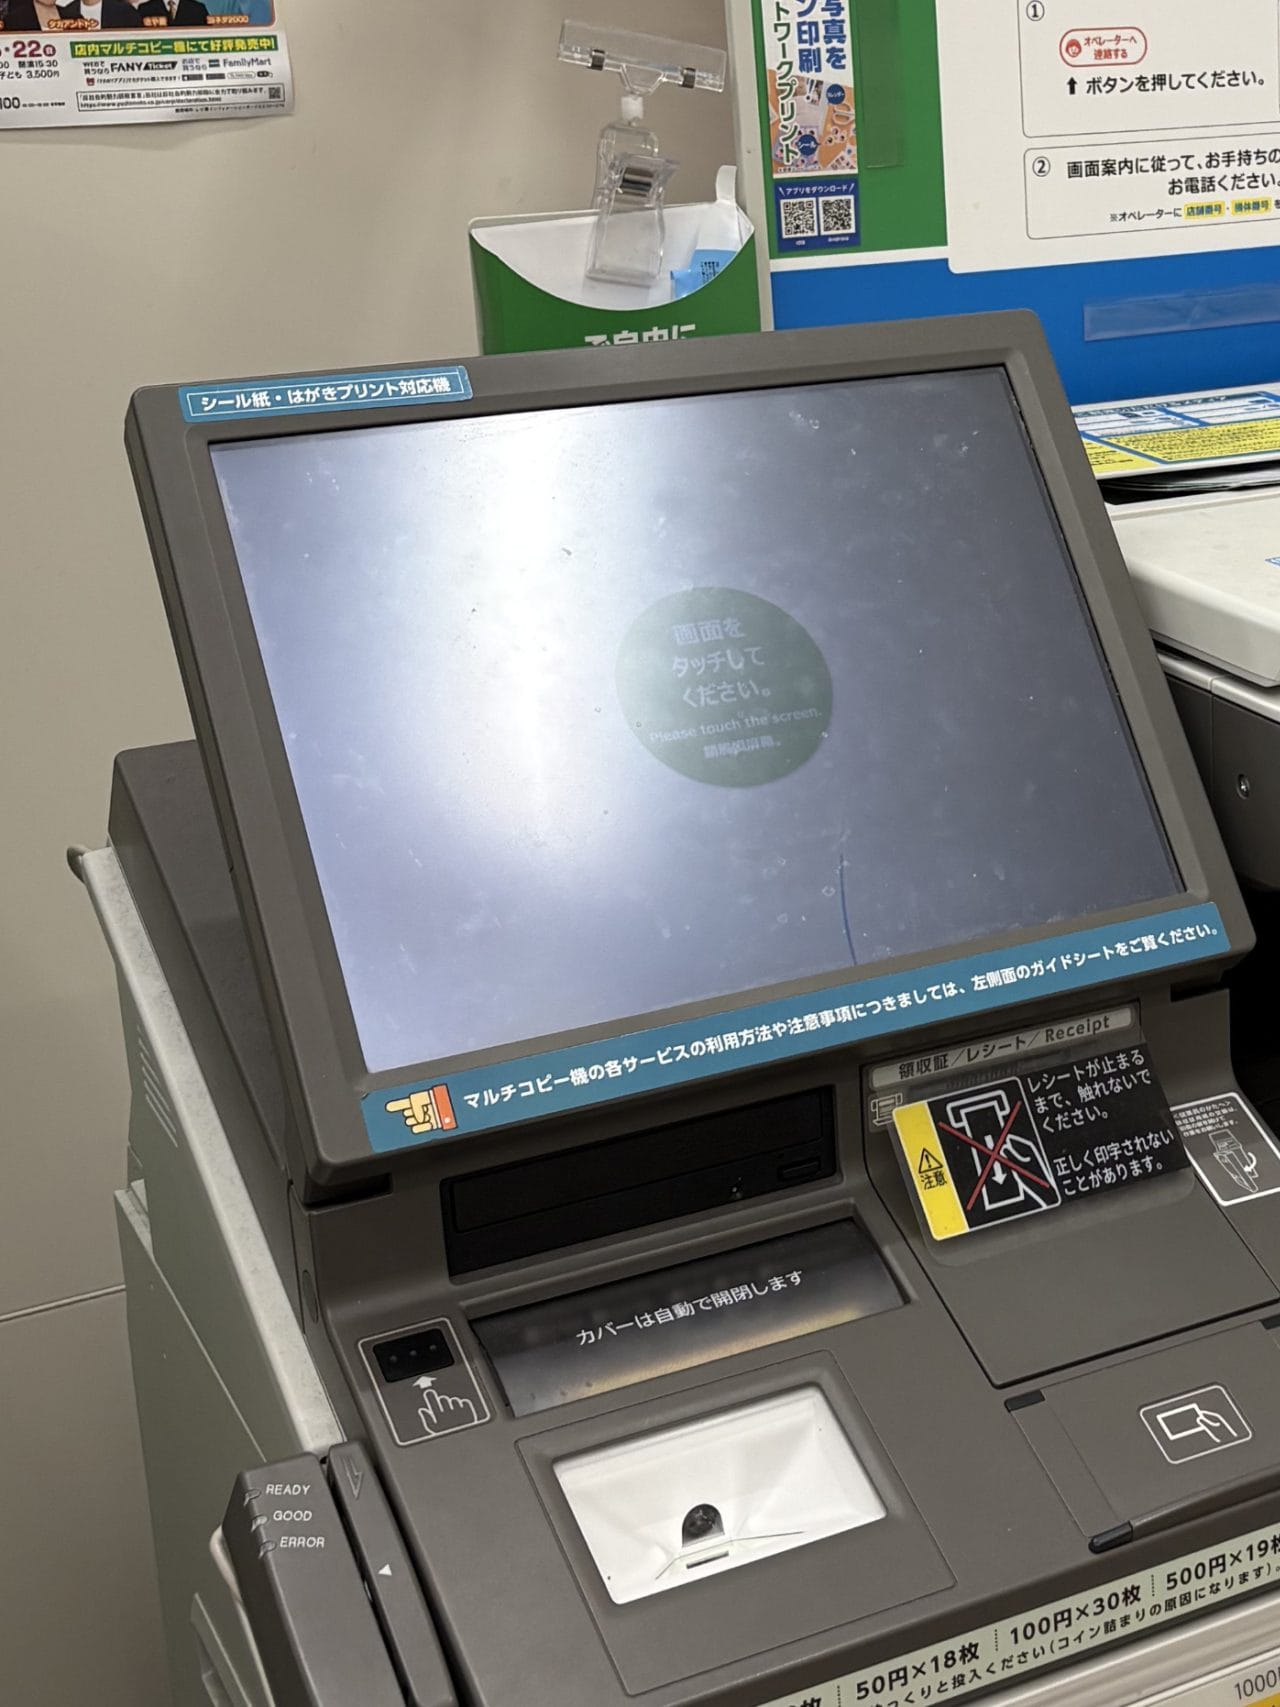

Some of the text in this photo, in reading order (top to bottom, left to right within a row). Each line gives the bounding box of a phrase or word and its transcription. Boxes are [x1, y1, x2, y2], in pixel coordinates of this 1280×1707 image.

[1083, 34, 1138, 48] オペレーターへ
[110, 62, 143, 72] FANY
[223, 58, 272, 67] FamilyMart
[1086, 70, 1266, 95] ボタンを押してください。
[201, 375, 452, 412] シール紙・はがきプリント対応機
[672, 617, 745, 646] 画面を
[672, 646, 765, 678] タッチして
[682, 679, 771, 708] ください。
[700, 719, 741, 736] touch
[744, 711, 768, 729] the
[463, 922, 1220, 1110] マルチコピー機の各サービスの利用方法や注意事項につきましては、左側面のガイドシートをご覧ください。
[1027, 1049, 1147, 1092] レシートが止まる
[1034, 1068, 1153, 1114] まで、触れないで
[1042, 1108, 1111, 1133] ください。
[1053, 1128, 1175, 1177] 正しく印字されない
[921, 1171, 947, 1190] 注意
[1063, 1154, 1164, 1195] ことがあります。
[575, 1270, 803, 1346] カバーは自動で開閉します
[266, 1484, 311, 1496] READY
[273, 1510, 312, 1522] GOOD
[279, 1536, 325, 1548] ERROR
[856, 1641, 980, 1700] 50円×18枚
[1009, 1584, 1142, 1646] 100円×30枚
